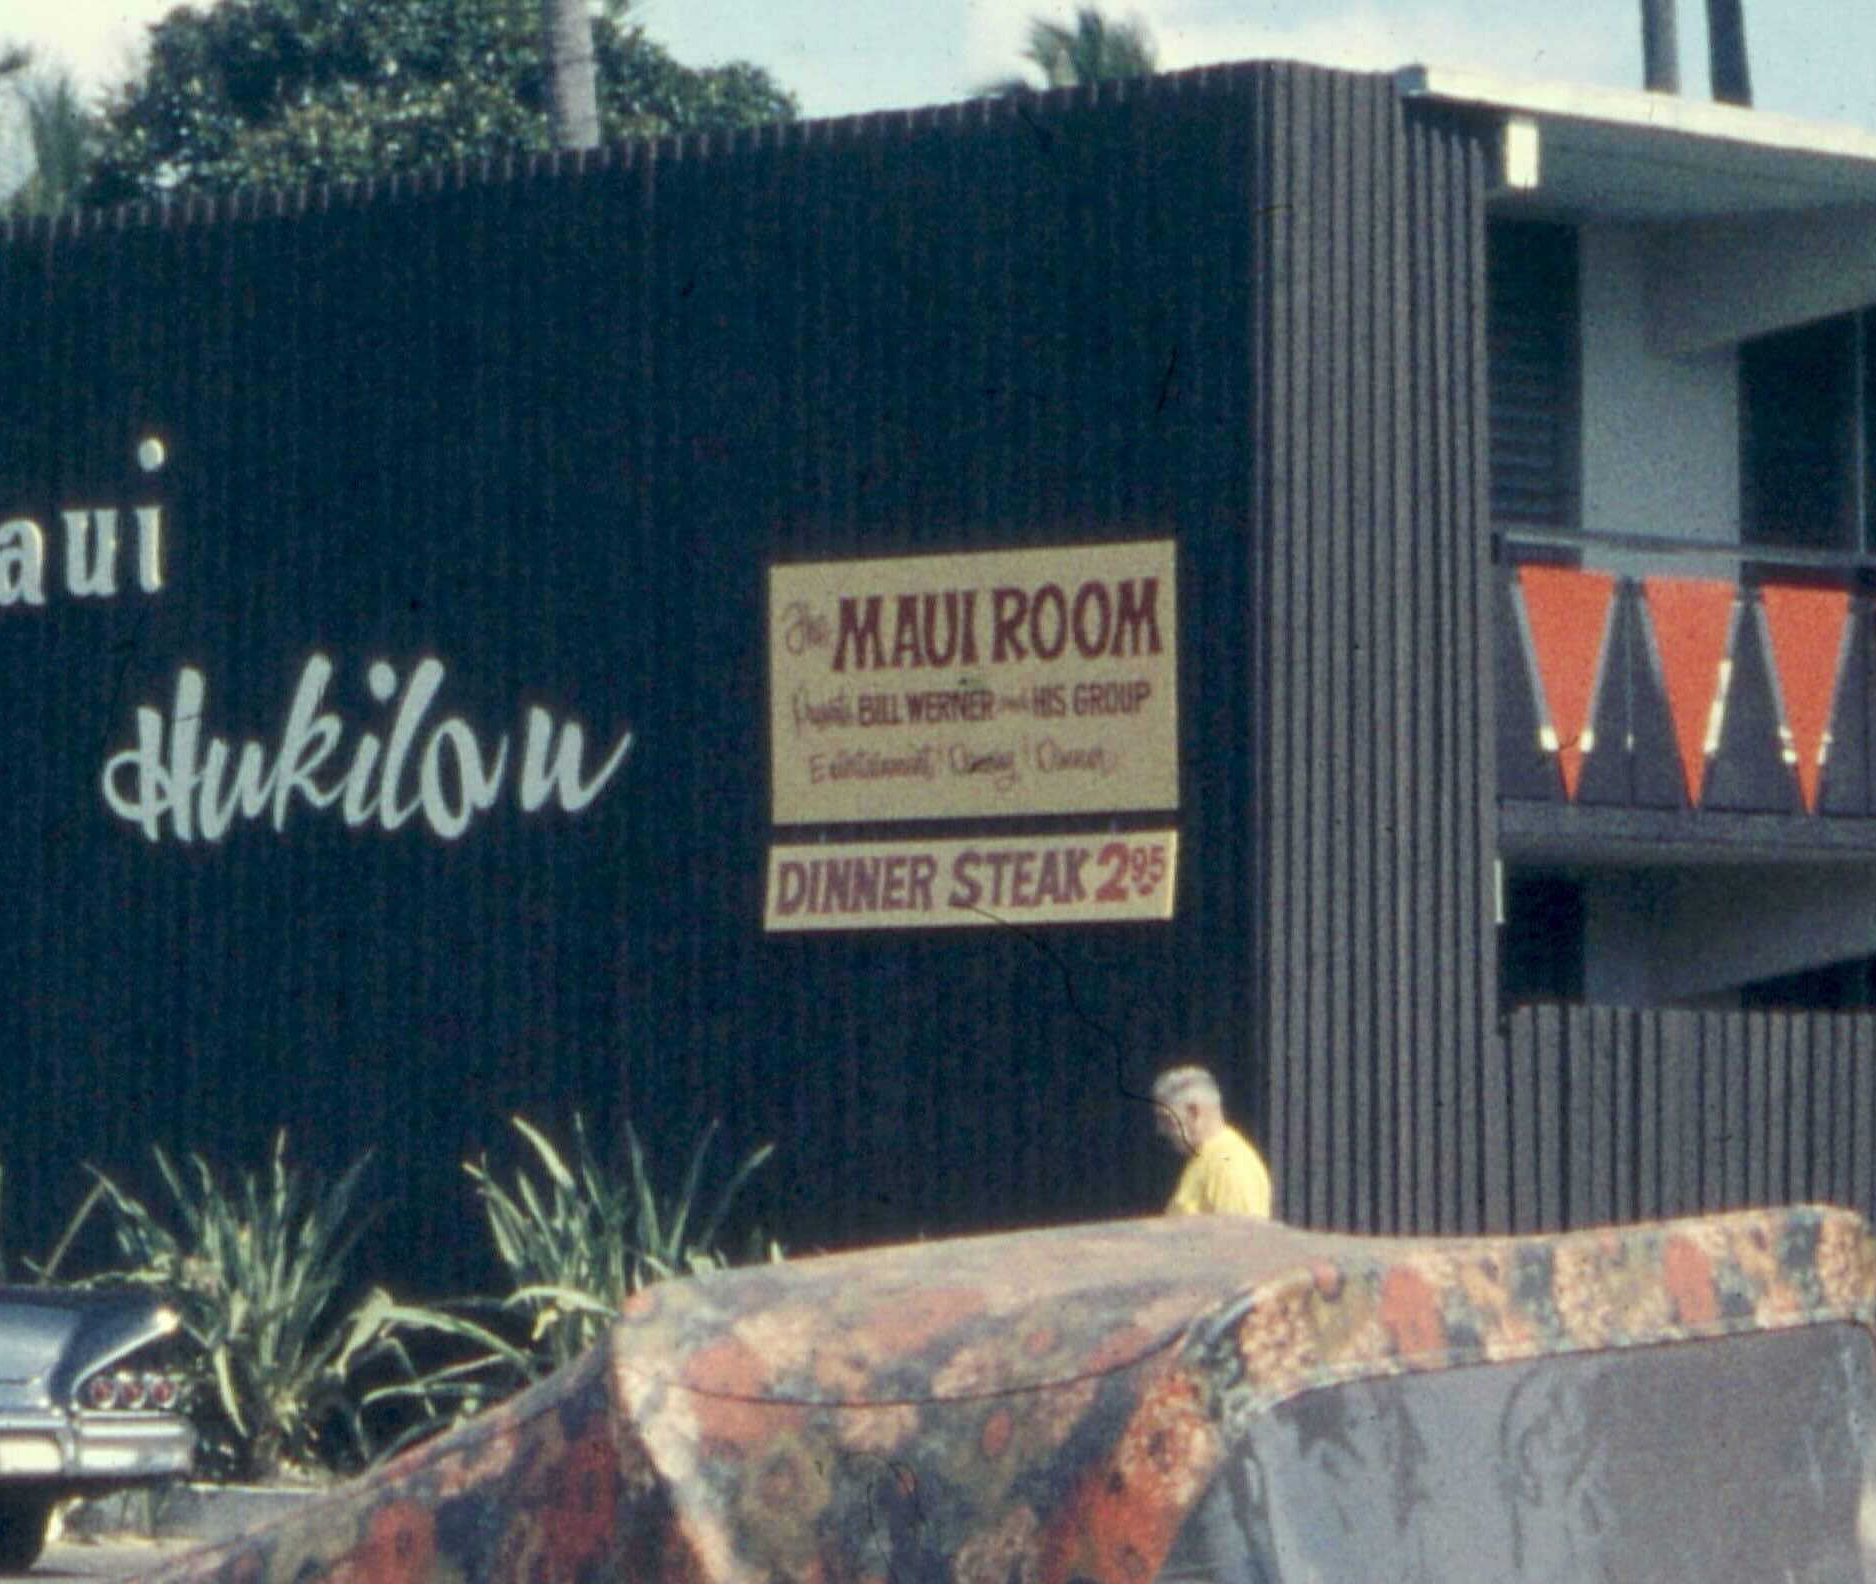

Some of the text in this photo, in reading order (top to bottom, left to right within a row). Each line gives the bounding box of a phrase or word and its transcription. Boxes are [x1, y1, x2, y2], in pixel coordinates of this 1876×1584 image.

[830, 587, 980, 673] MAUI
[991, 575, 1164, 665] ROOM
[858, 691, 901, 727] BILL
[905, 687, 995, 726] WERNER
[1032, 683, 1067, 719] HIS
[1074, 680, 1151, 717] GROUP
[101, 652, 635, 843] Hukilau
[777, 852, 938, 916] DINNER
[947, 847, 1090, 910] STEAK
